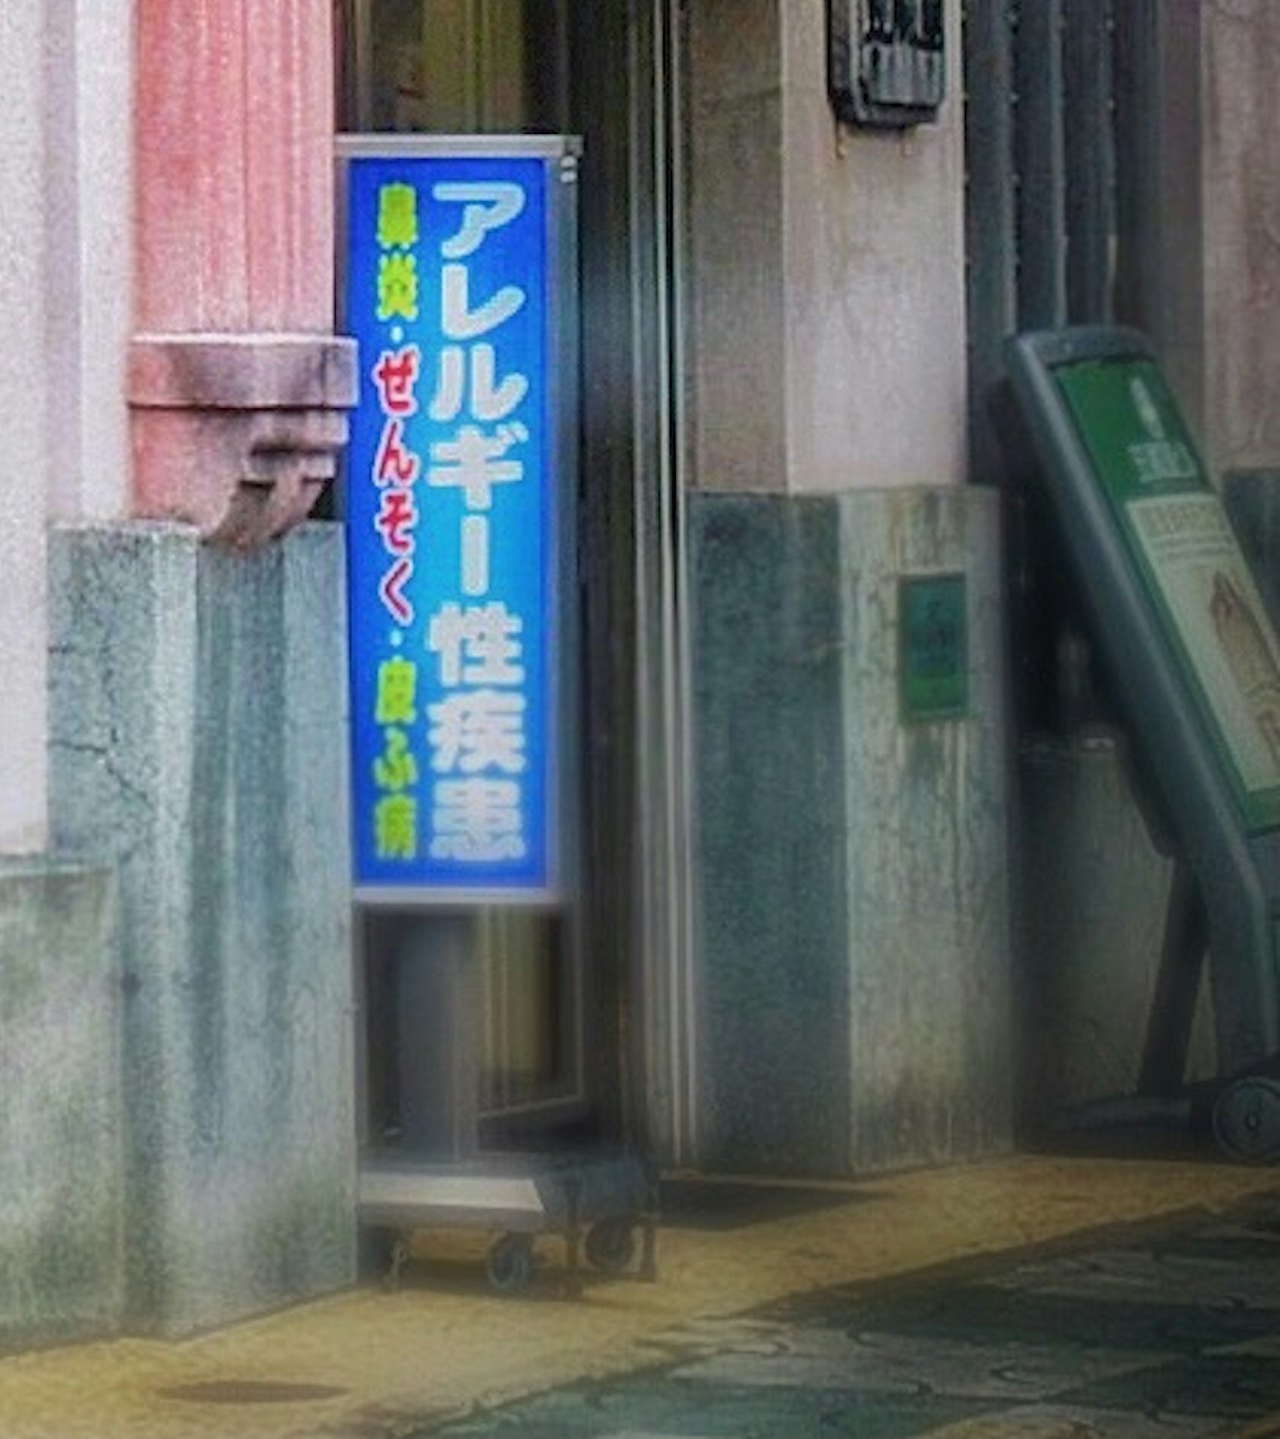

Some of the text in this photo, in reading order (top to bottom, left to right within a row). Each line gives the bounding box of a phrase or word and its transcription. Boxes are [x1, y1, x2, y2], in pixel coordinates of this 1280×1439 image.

[425, 181, 527, 861] アレルギー性疾患
